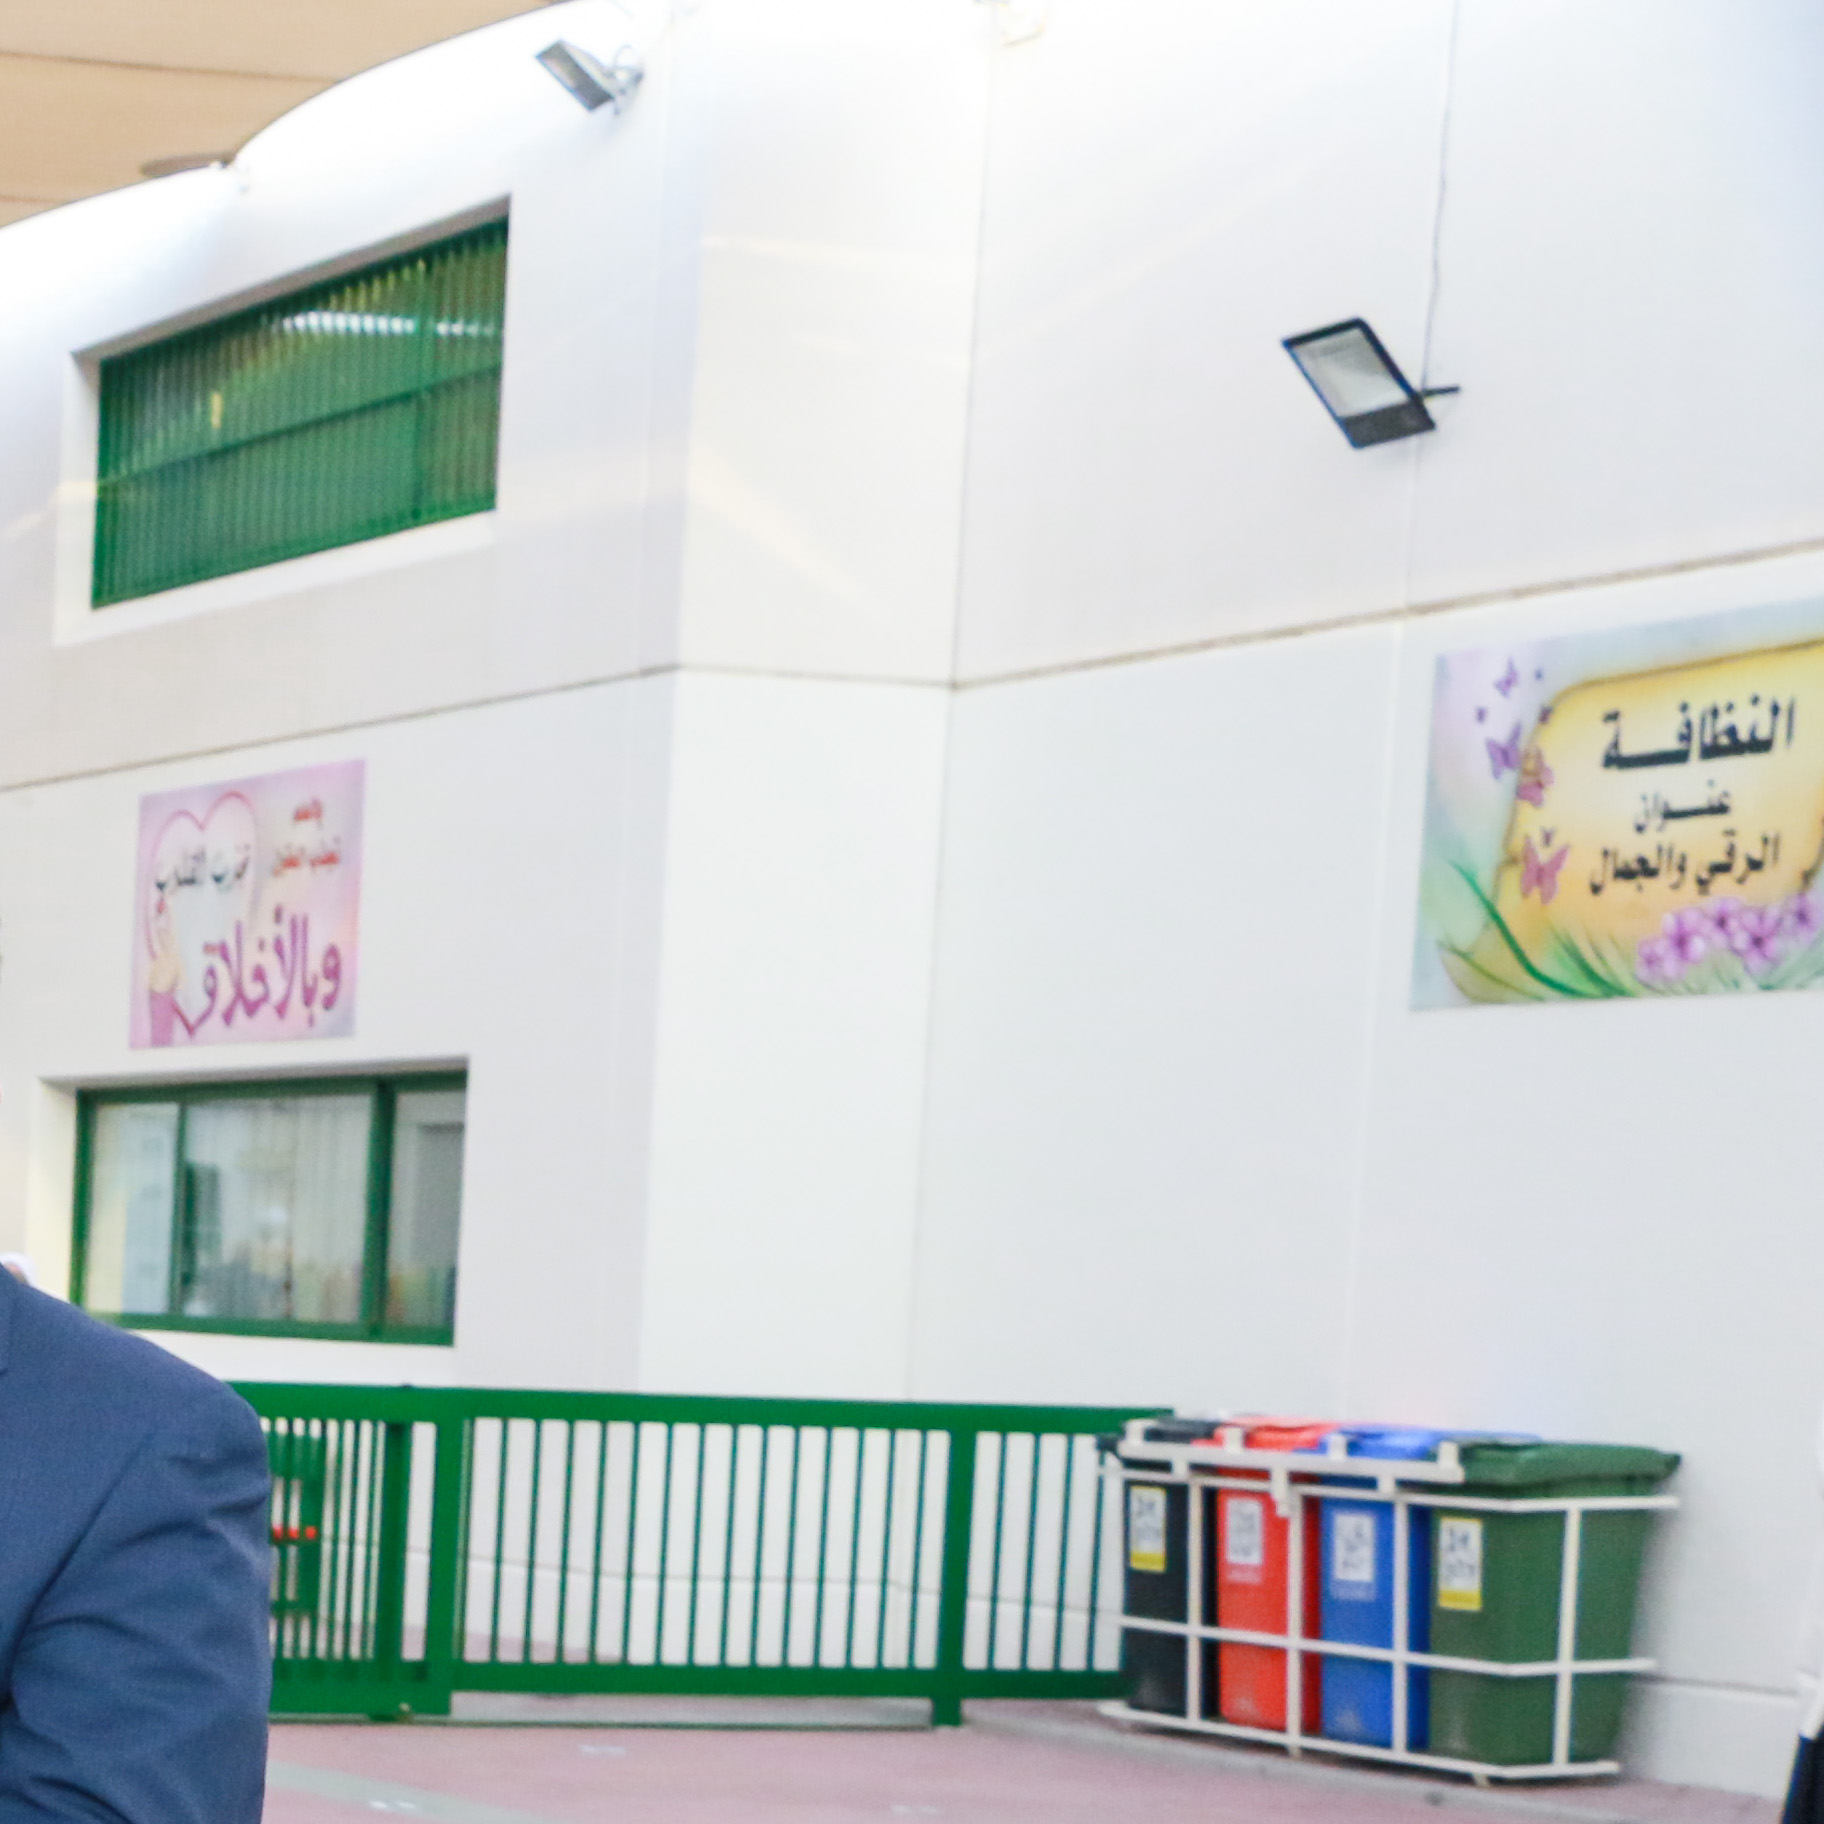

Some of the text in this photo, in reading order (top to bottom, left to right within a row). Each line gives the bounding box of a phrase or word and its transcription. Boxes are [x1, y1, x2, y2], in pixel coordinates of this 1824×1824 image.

[1603, 693, 1794, 769] النظافة
[1634, 779, 1730, 833] عنوان
[1589, 828, 1780, 896] الرقي والجمال
